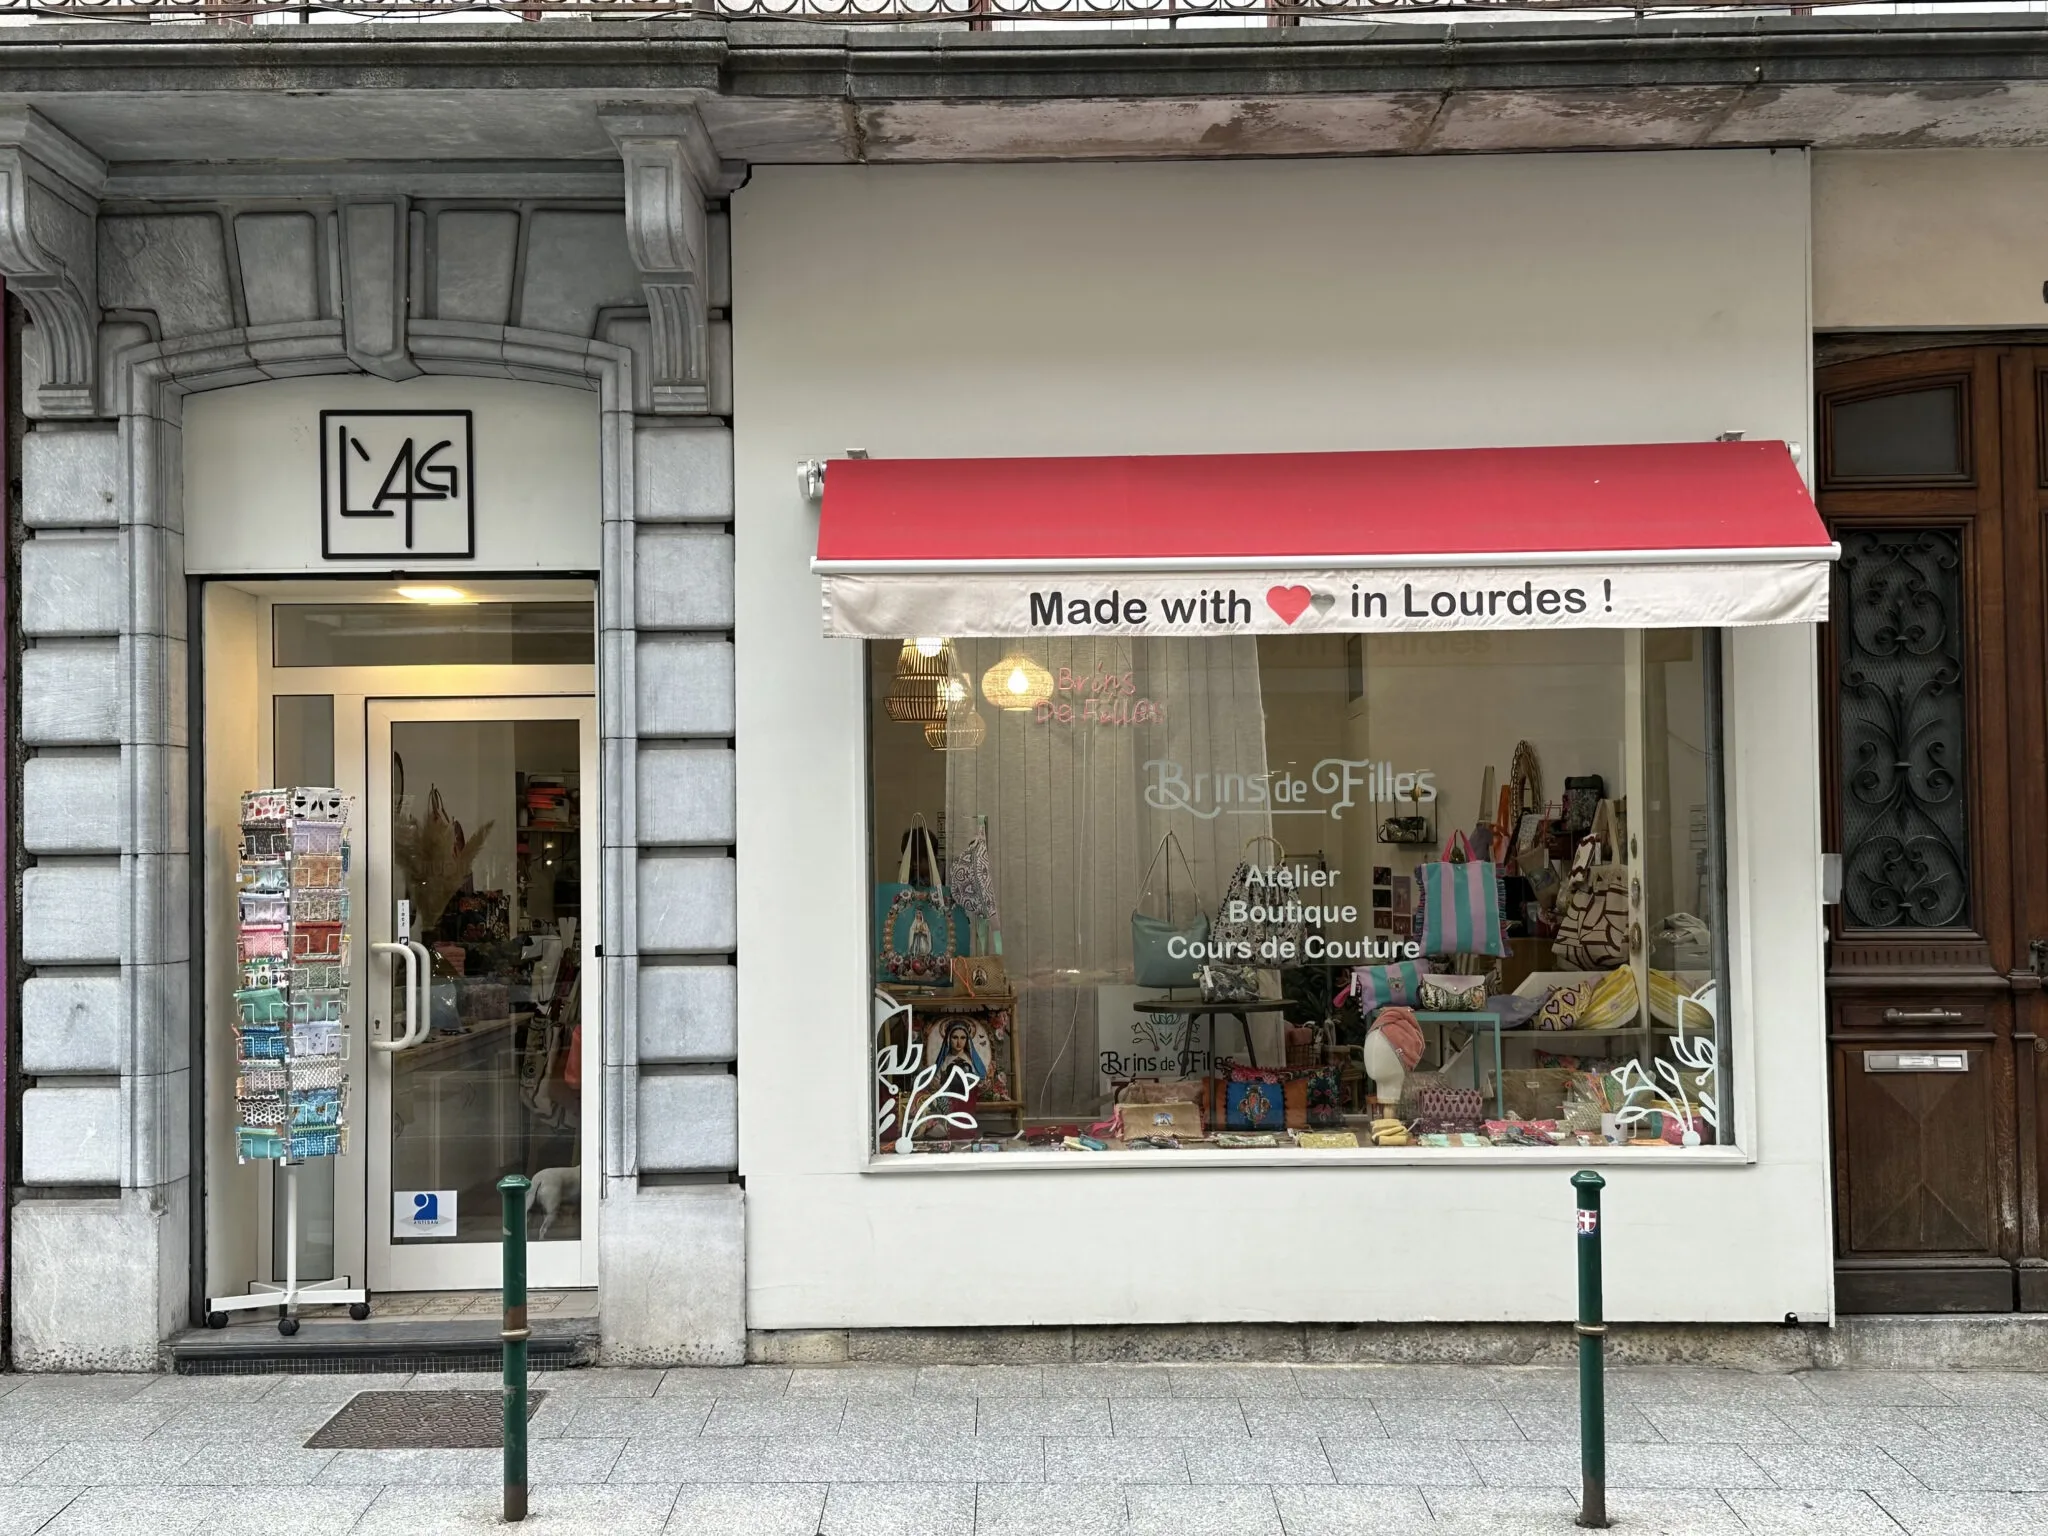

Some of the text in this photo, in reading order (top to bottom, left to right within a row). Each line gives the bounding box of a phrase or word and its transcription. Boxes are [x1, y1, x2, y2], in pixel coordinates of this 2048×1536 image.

[1030, 578, 1613, 626] Made with in Lourdes !
[1058, 661, 1136, 695] Brins
[1143, 758, 1437, 820] Brins de Filles
[1245, 864, 1340, 888] Atelier
[1229, 901, 1357, 928] Boutique
[1167, 935, 1420, 959] Cours de Couture
[1100, 1051, 1157, 1079] Brins
[1160, 1056, 1176, 1071] de
